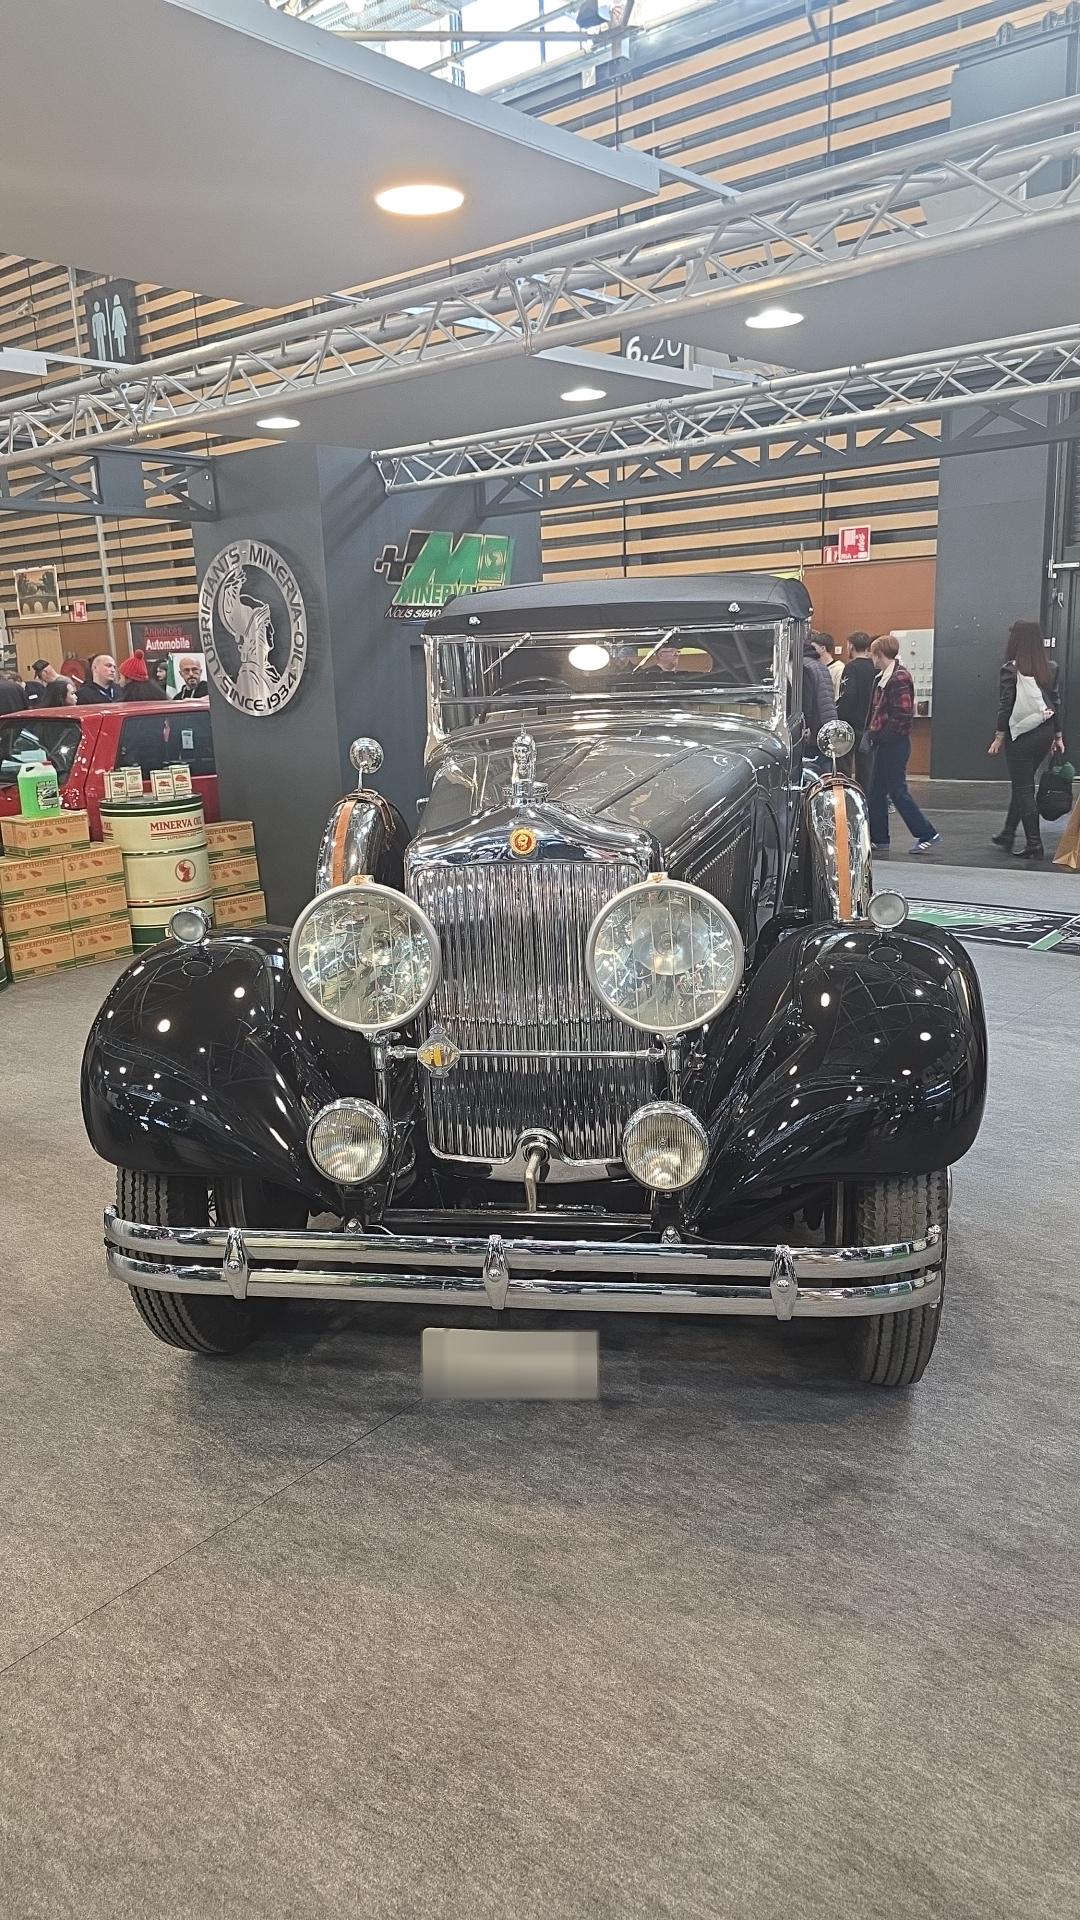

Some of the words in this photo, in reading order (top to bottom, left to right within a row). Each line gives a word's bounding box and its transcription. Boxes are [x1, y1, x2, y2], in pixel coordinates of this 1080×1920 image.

[201, 546, 240, 677] LUBRIFIANTS
[145, 637, 190, 650] Automobile
[220, 675, 264, 712] SINCE
[266, 674, 298, 709] 1934
[150, 818, 193, 831] MINERVA
